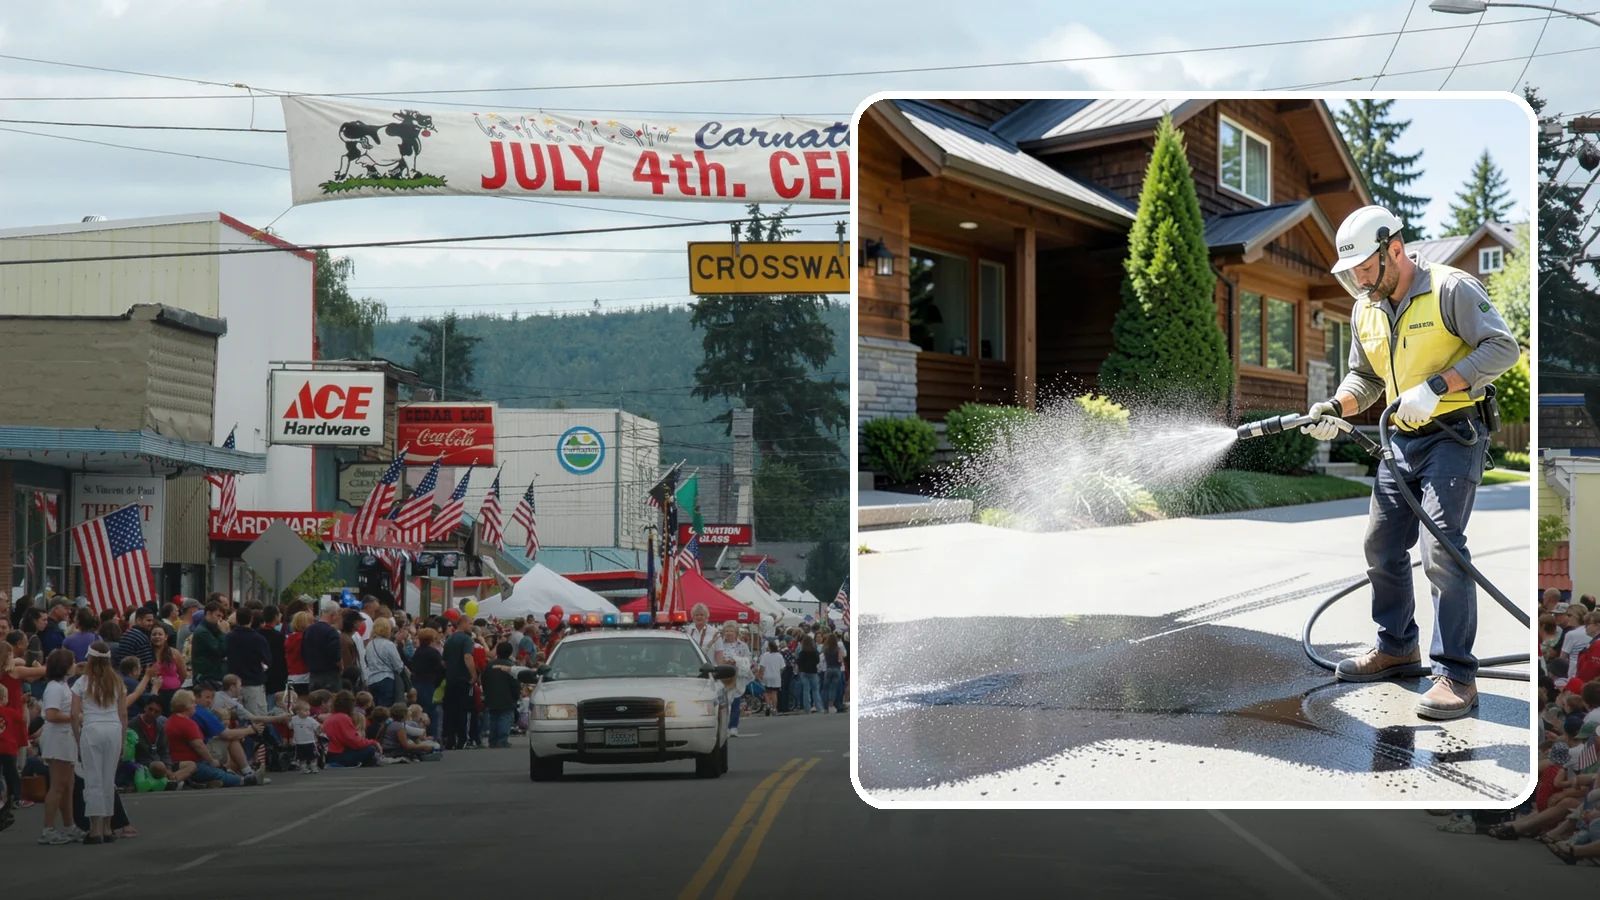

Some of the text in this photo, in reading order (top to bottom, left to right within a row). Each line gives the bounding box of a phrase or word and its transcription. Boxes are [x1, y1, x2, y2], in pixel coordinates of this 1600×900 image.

[481, 140, 605, 192] JULY
[632, 149, 747, 198] 4th.
[696, 253, 851, 281] CROSSWA
[282, 379, 374, 420] ACE
[405, 409, 486, 422] CEDAR LOG
[283, 421, 371, 437] Hardware
[416, 428, 478, 447] Coca-Cola
[353, 467, 385, 480] Simpl
[96, 484, 124, 495] Vincent
[126, 485, 136, 495] de
[137, 485, 155, 496] Paul
[212, 515, 331, 536] HARDARE
[688, 526, 742, 536] CRNATION
[699, 535, 731, 544] GLASS
